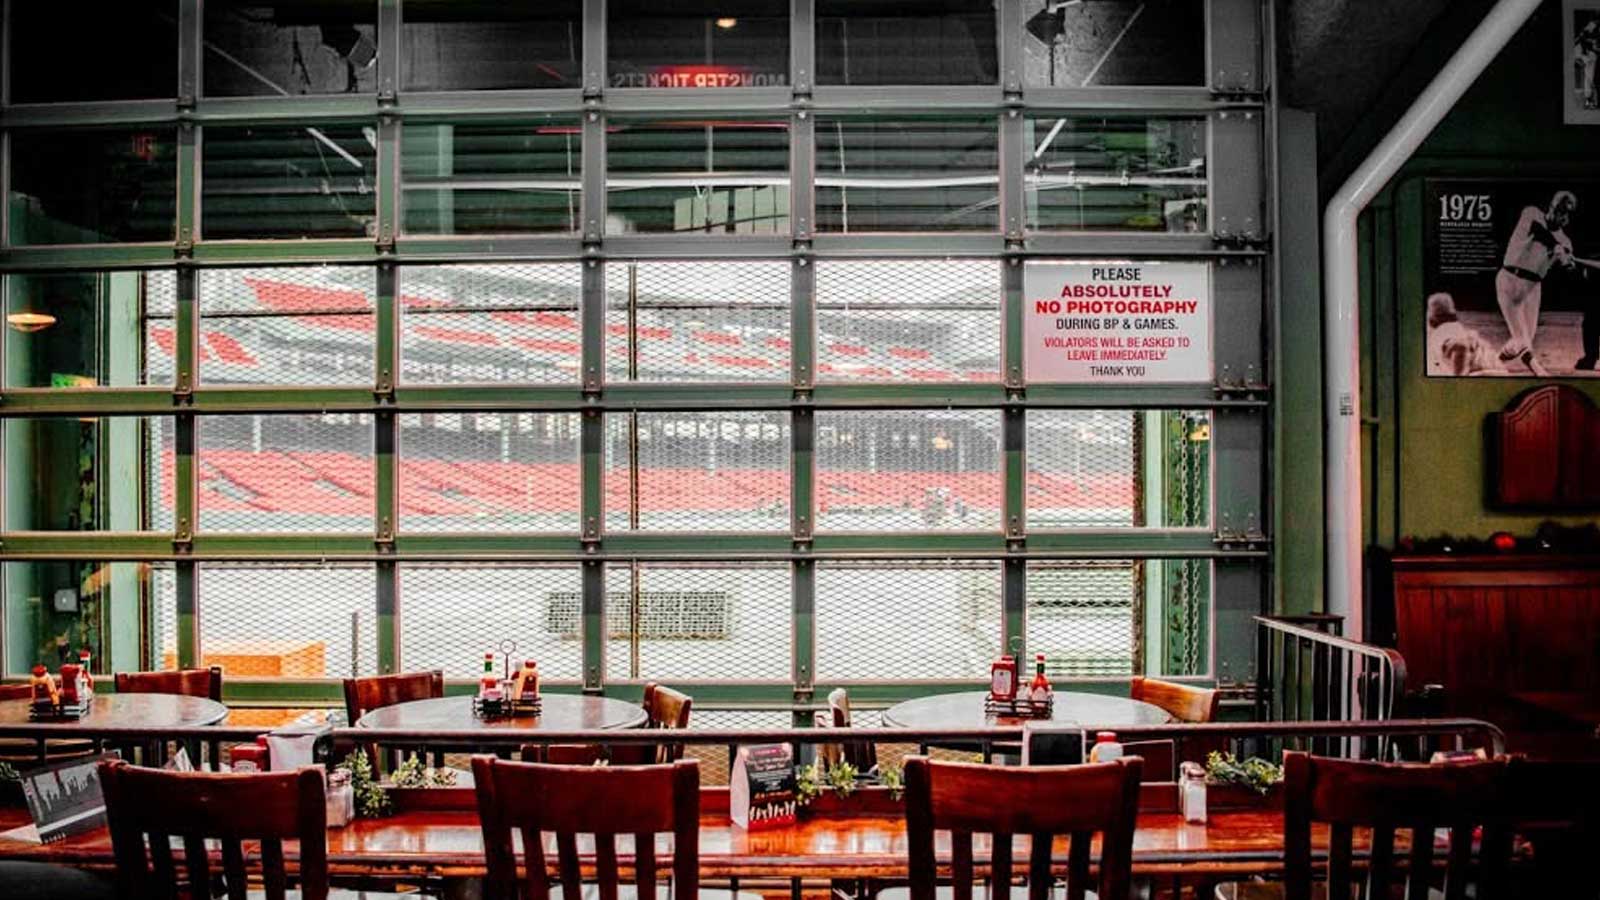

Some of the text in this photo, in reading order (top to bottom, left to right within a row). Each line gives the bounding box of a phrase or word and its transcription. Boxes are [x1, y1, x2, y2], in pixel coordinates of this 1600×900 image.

[1439, 194, 1493, 221] 1975
[1092, 267, 1142, 281] PLEASE
[1061, 285, 1173, 298] ABSOLUTELY
[1036, 301, 1198, 314] NO PHOTOGRAPHY
[1056, 318, 1180, 330] DURING BP & GAMES.
[1044, 336, 1190, 348] VIOLATORS WILL BE ASKED TO
[1067, 350, 1098, 361] LEAVE
[1090, 365, 1146, 377] THANK YOU
